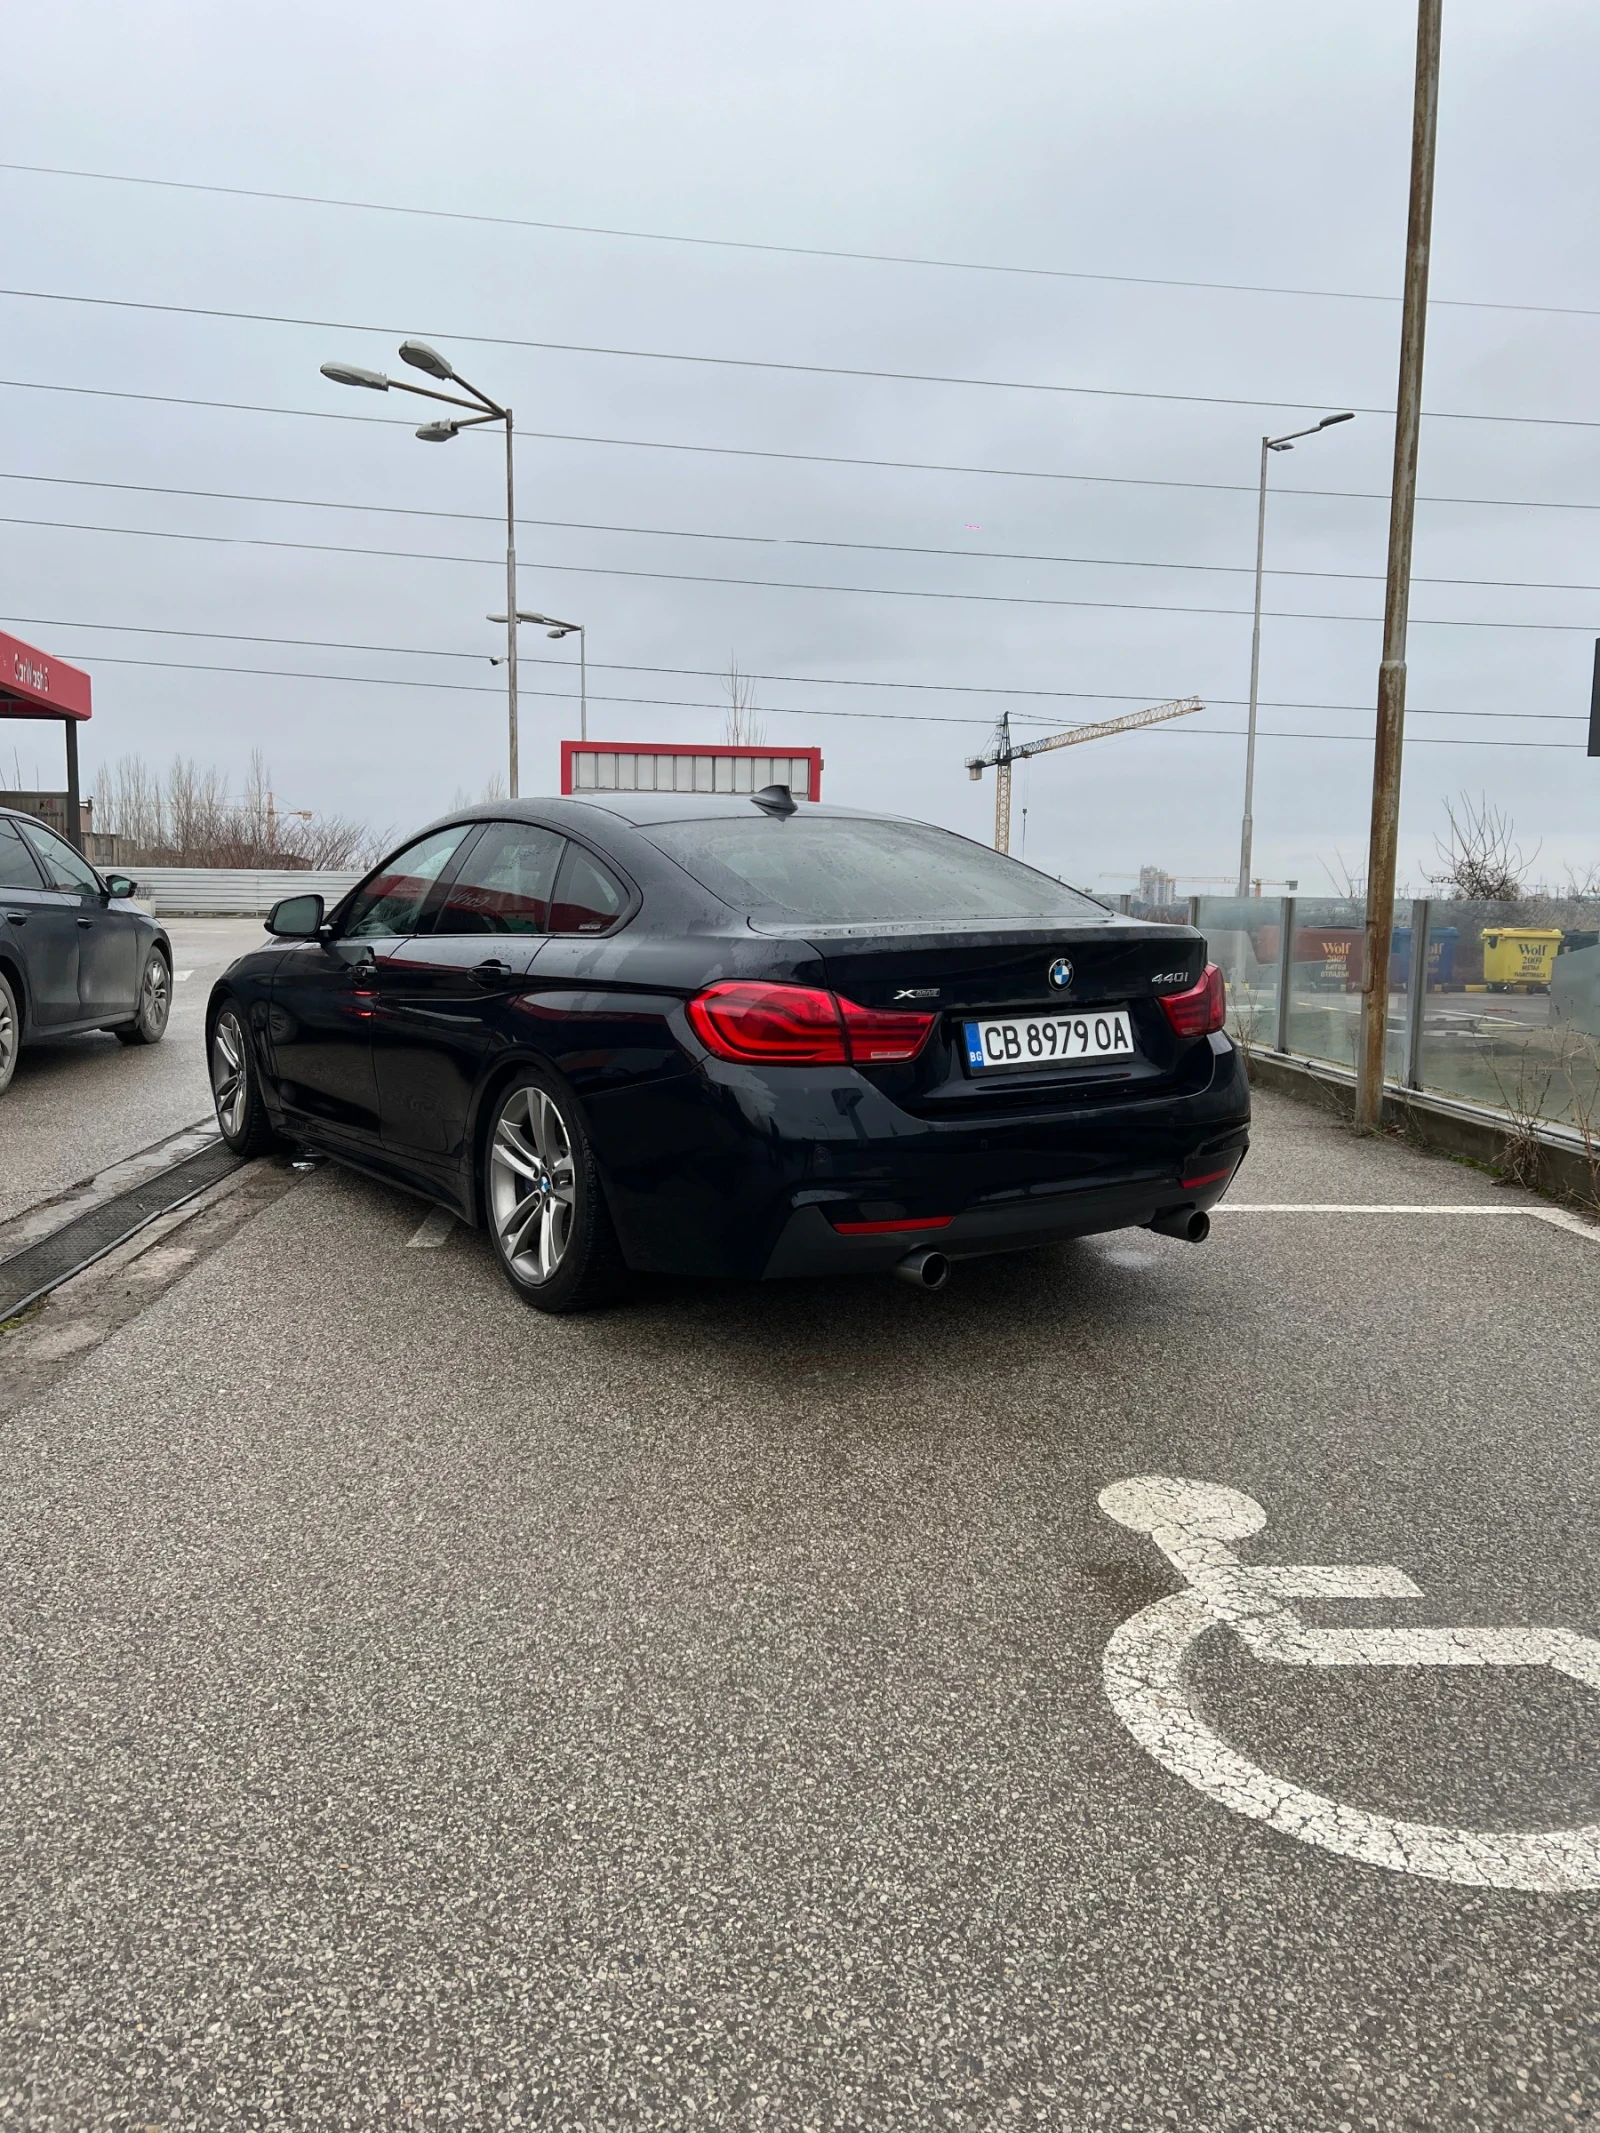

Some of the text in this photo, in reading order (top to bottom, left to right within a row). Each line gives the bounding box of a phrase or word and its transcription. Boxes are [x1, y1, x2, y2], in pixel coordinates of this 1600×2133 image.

[1321, 942, 1352, 954] Wolf
[1518, 944, 1549, 956] Wolf
[1522, 956, 1543, 965] 2009
[985, 1025, 1022, 1061] CB
[1026, 1019, 1089, 1057] 8979
[969, 1051, 983, 1062] BG
